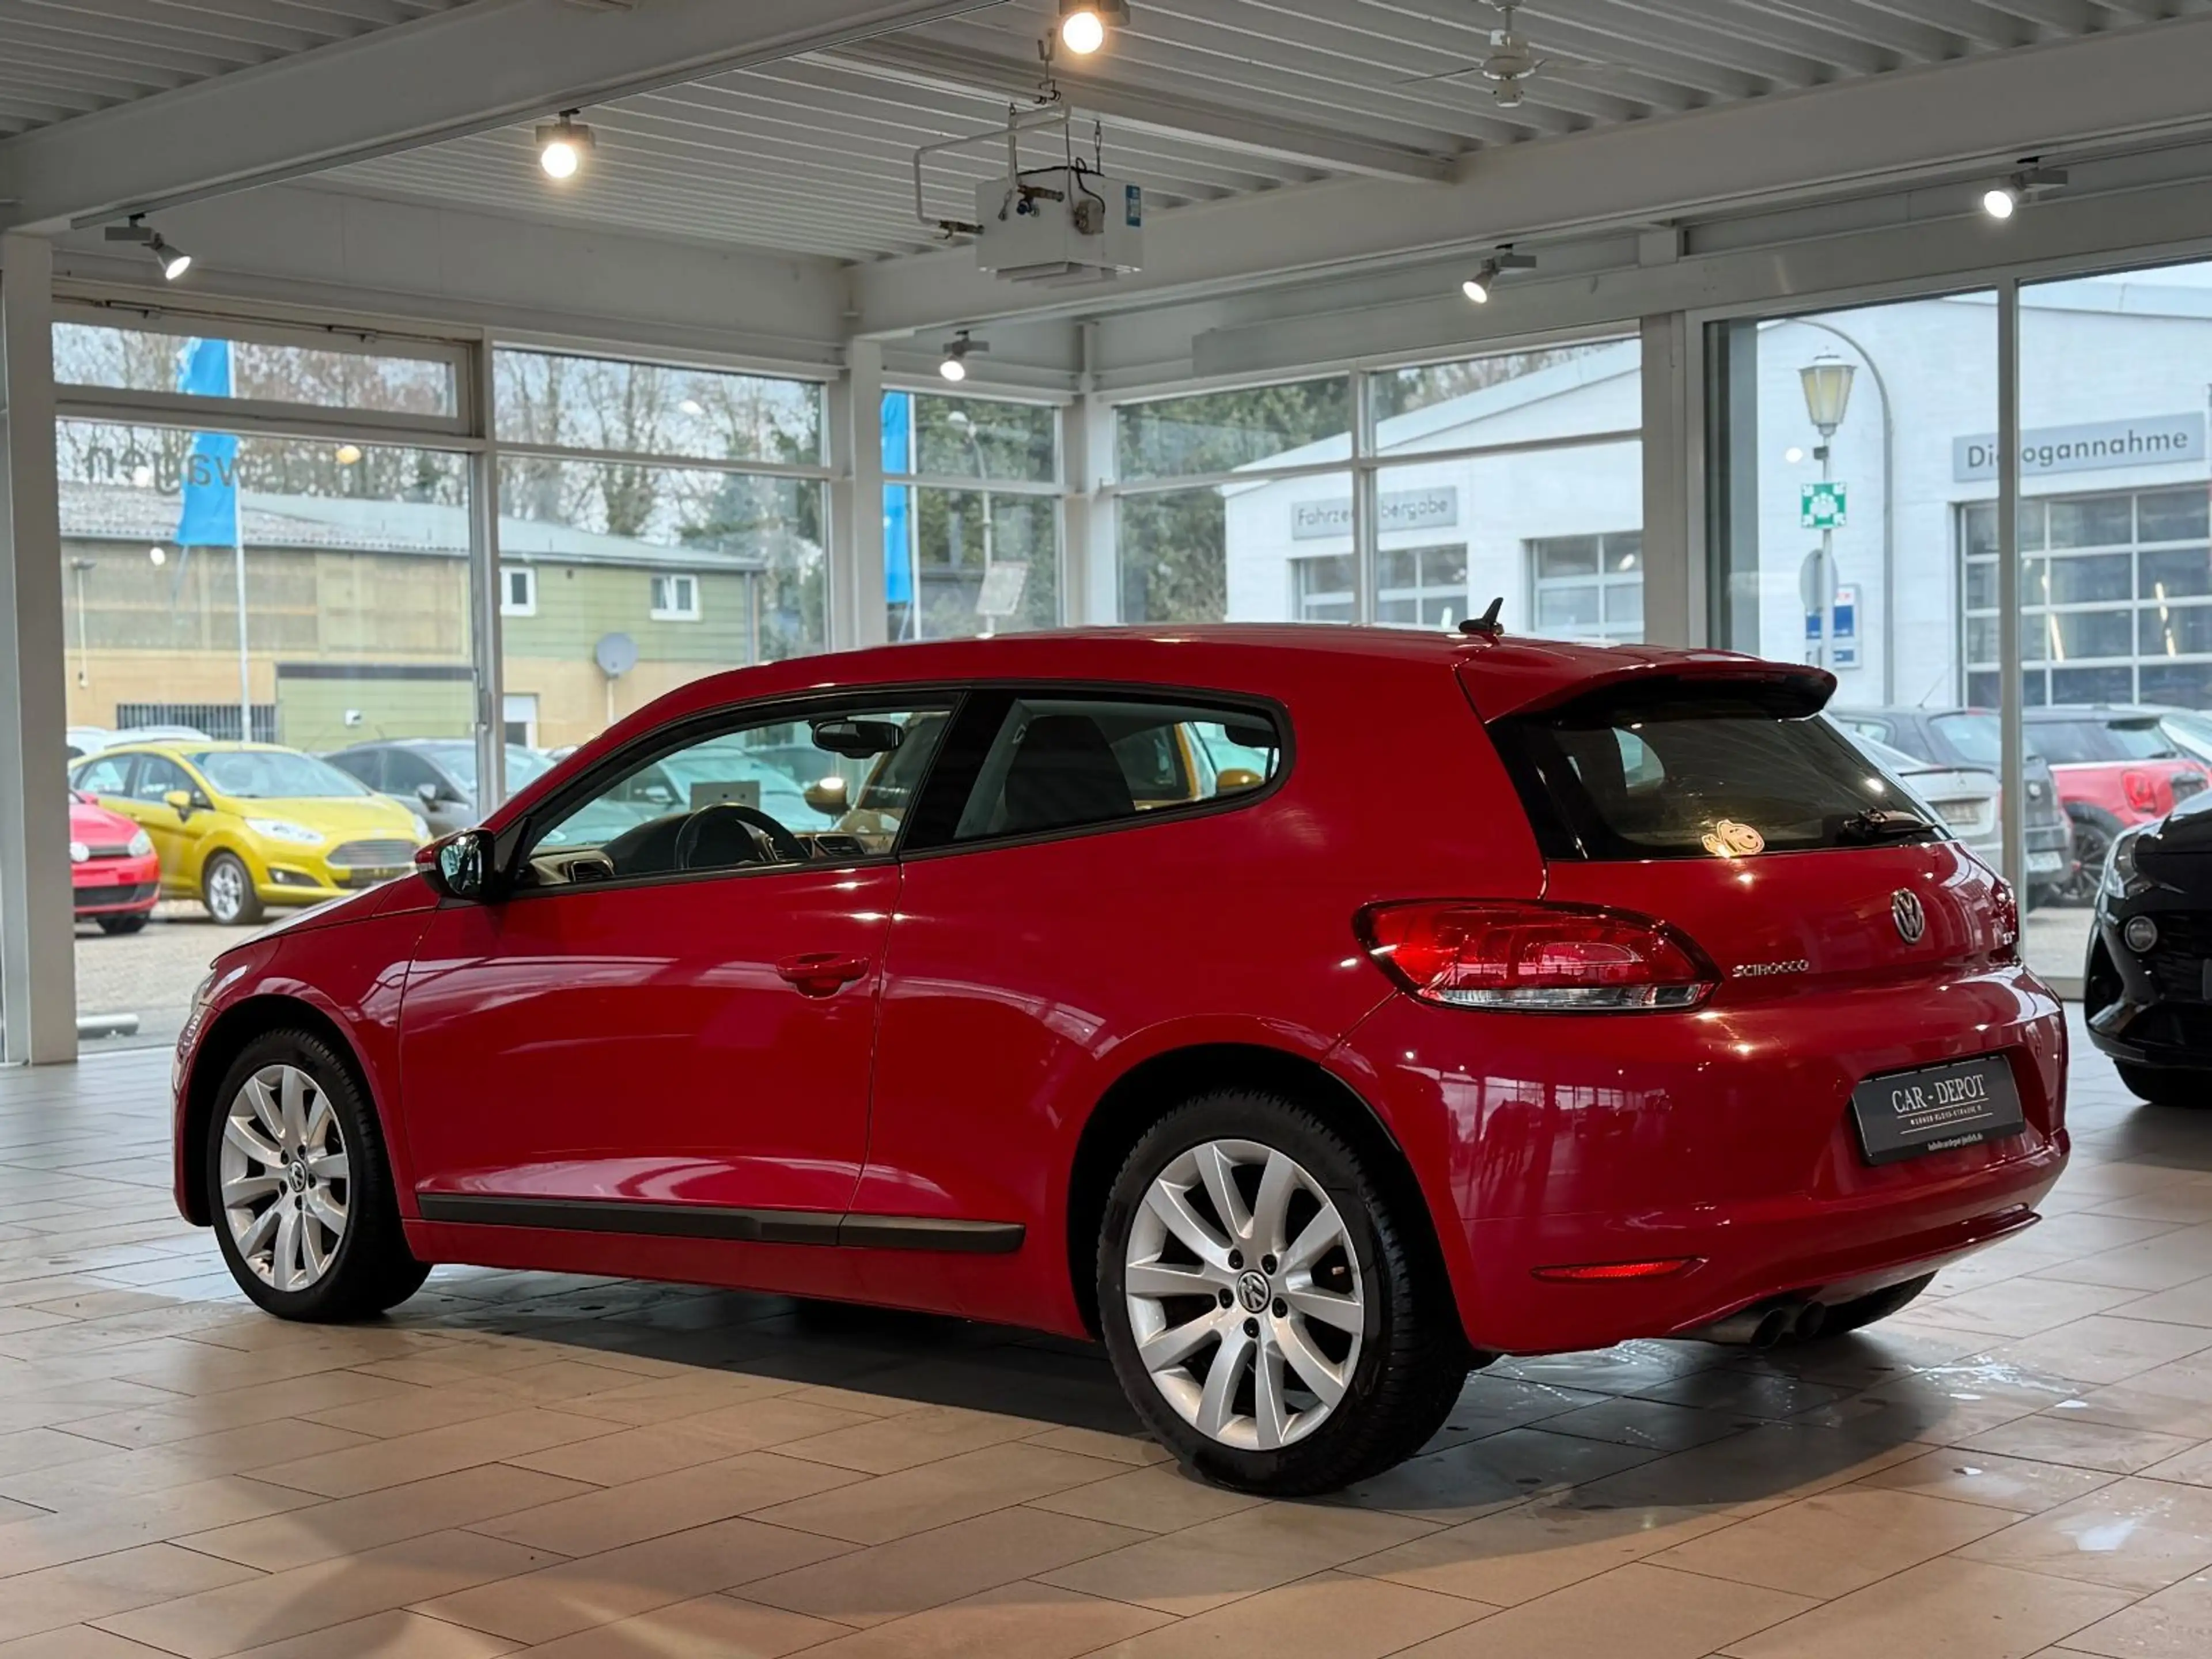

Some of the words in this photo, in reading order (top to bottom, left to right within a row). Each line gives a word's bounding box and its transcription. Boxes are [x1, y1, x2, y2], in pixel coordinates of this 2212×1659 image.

[1968, 429, 2188, 468] Diogannahme
[1297, 493, 1448, 527] Fahrzebergabe
[1732, 959, 1809, 978] SCIROCCO
[1892, 1086, 1927, 1113] CAR
[1934, 1074, 1986, 1104] DEPOT
